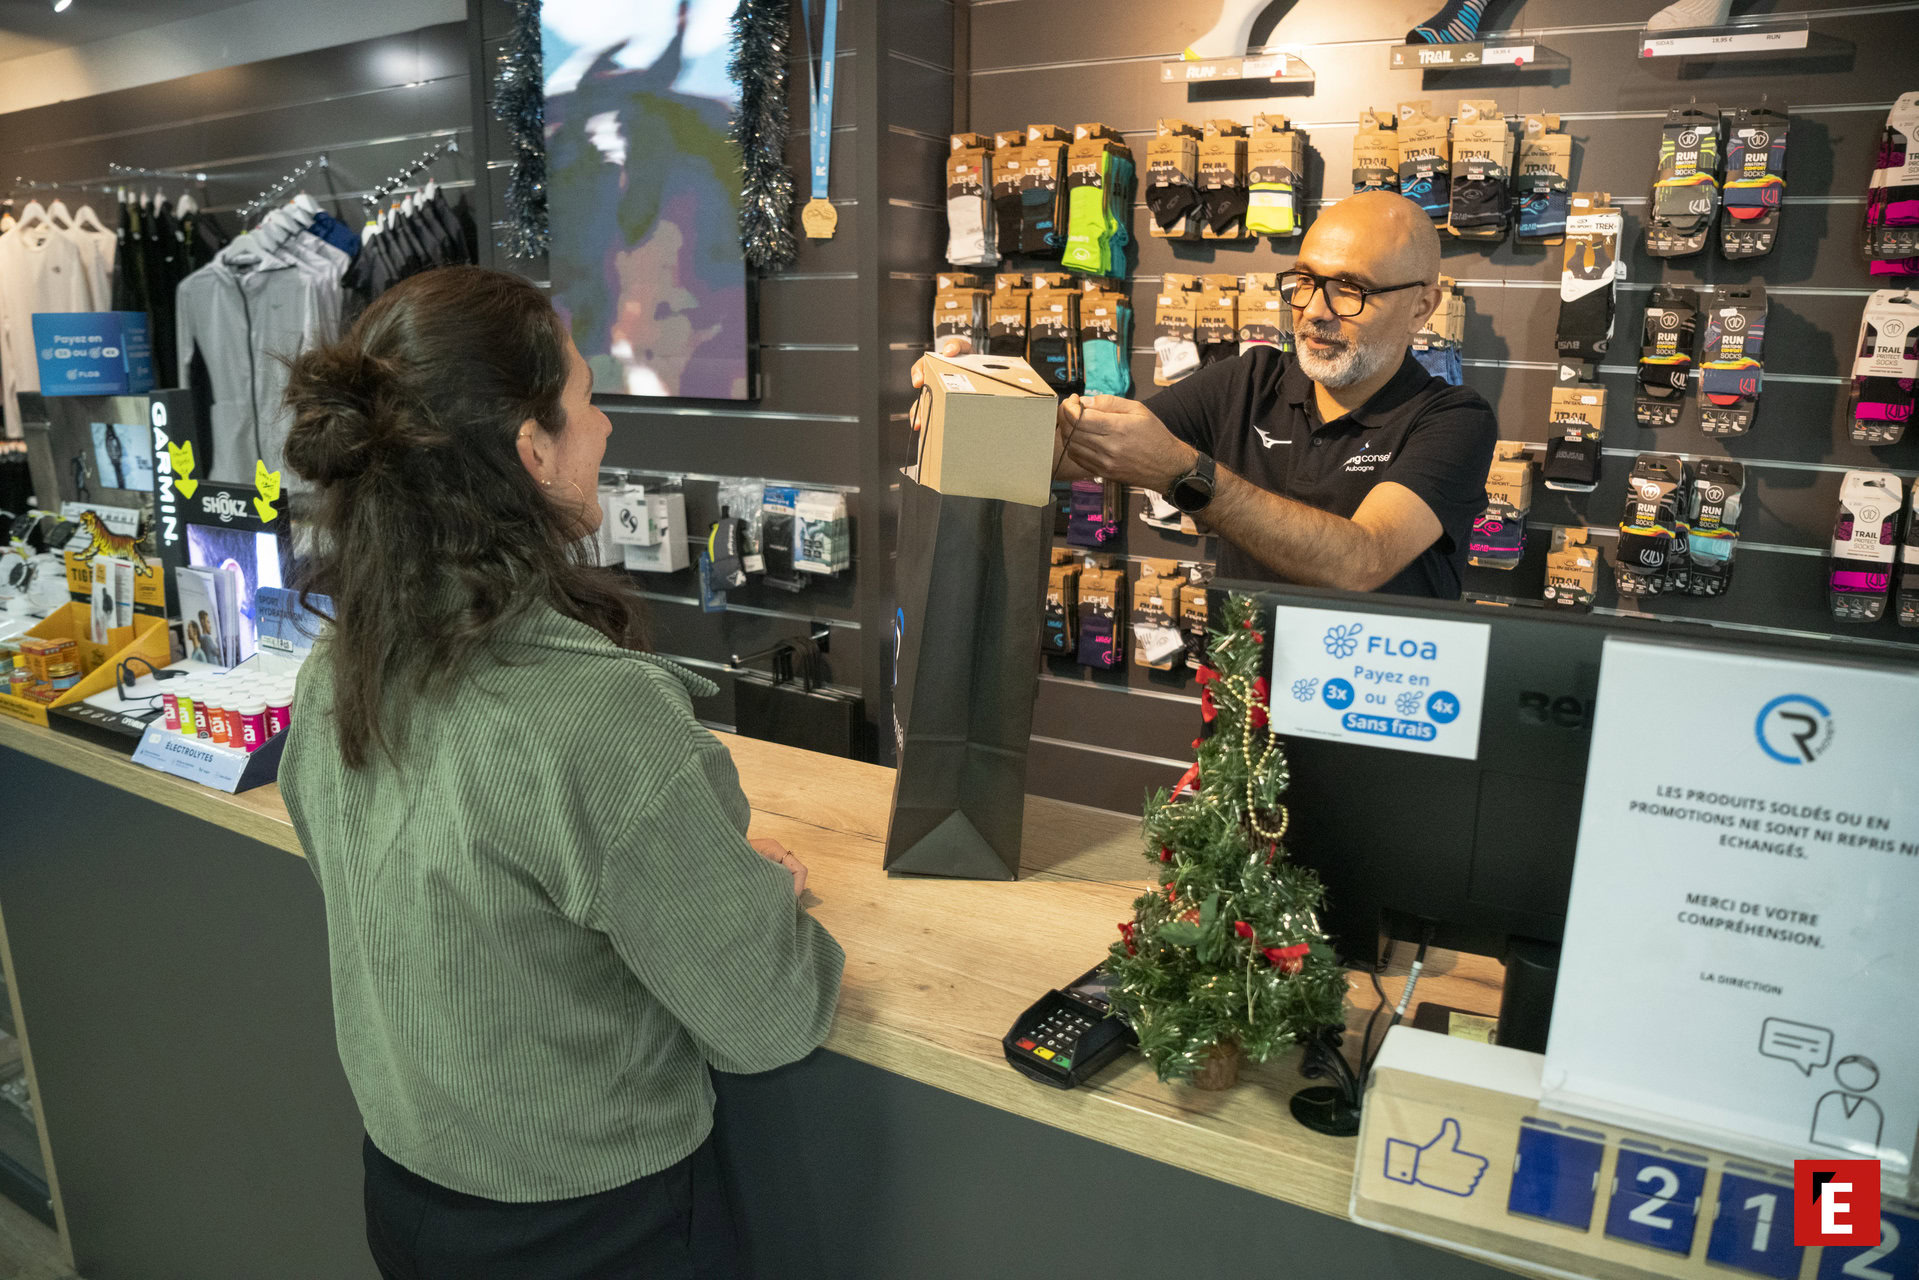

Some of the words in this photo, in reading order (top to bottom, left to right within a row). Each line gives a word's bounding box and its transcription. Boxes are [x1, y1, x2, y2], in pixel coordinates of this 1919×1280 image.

[1419, 49, 1454, 64] TRAIL
[1404, 148, 1439, 162] TRAIL
[1458, 150, 1492, 162] TRAIL
[1676, 152, 1698, 160] RUN
[1745, 153, 1768, 162] RUN
[1524, 164, 1558, 176] TRAIL
[1675, 168, 1696, 176] SOCKS
[1658, 332, 1678, 341] RUN
[1722, 336, 1744, 344] RUN
[1877, 346, 1902, 354] TRAIL
[1554, 412, 1589, 425] TRAIL
[152, 402, 178, 541] GARMIN
[202, 496, 248, 518] SHOKZ
[1638, 503, 1656, 513] RUN
[1702, 506, 1722, 515] RUN
[1636, 520, 1654, 528] SOCKS
[1855, 530, 1878, 539] TRAIL
[1550, 575, 1583, 588] TRAIL
[1354, 666, 1402, 684] Payez
[1409, 675, 1430, 687] en
[1326, 684, 1347, 700] 3x
[1365, 692, 1386, 704] ou
[1432, 698, 1454, 714] 4x
[1347, 714, 1387, 732] Sans
[1392, 719, 1432, 738] frais
[1656, 784, 1682, 800] LES
[1686, 788, 1766, 812] PRODUITS
[1770, 800, 1832, 822] SOLDÉS
[1836, 810, 1862, 827] OU
[1866, 815, 1890, 831] EN
[1629, 800, 1736, 828] PROMOTIONS
[1740, 816, 1760, 832] NE
[1764, 820, 1810, 840] SONT
[1814, 828, 1834, 843] NI
[1837, 832, 1896, 854] REPRIS
[1900, 842, 1919, 858] NI
[1719, 834, 1808, 860] ECHANGÉS.
[1686, 892, 1736, 912] MERCI
[1740, 901, 1760, 917] DE
[1764, 906, 1819, 927] VOTRE
[1677, 912, 1826, 949] COMPRÉHENSION.
[1700, 972, 1715, 982] LA
[1718, 974, 1782, 996] DIRECTION
[1628, 1165, 1680, 1230] 2
[1744, 1193, 1778, 1252] 1
[1842, 1217, 1902, 1280] 2
